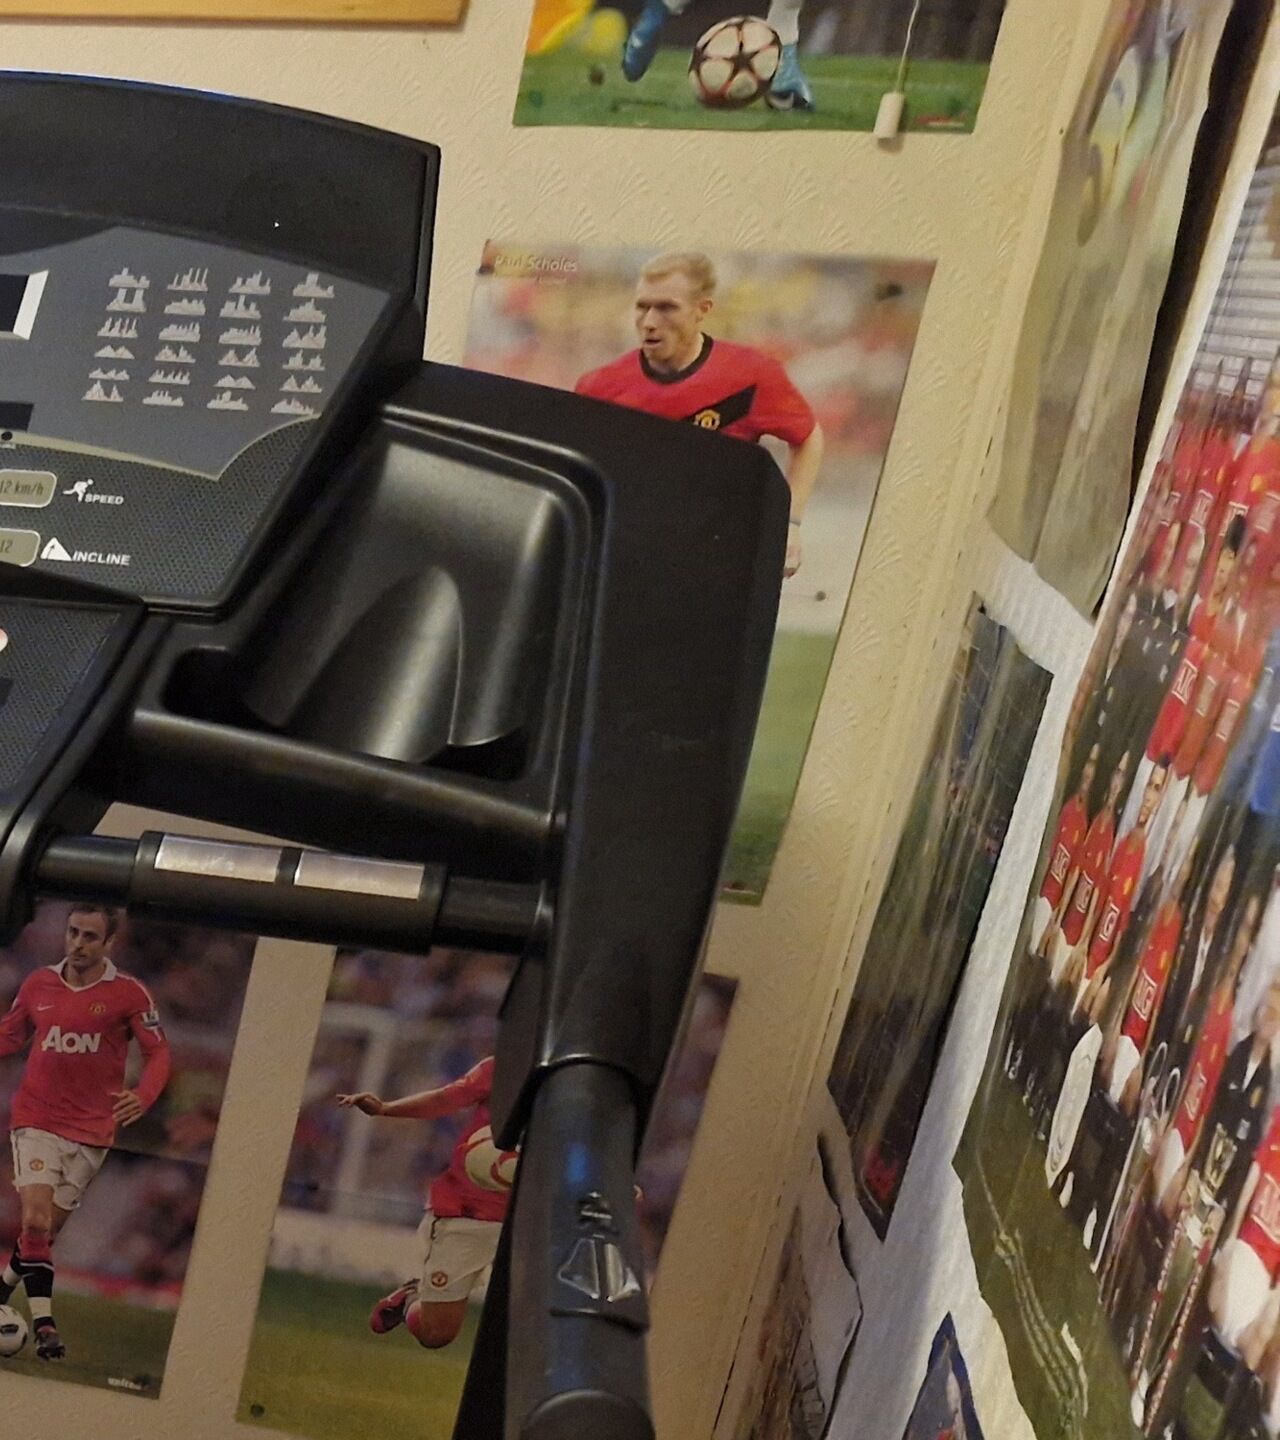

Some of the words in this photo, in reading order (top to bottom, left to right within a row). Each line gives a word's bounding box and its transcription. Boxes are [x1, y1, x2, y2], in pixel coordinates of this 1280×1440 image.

[527, 255, 577, 271] Scholes
[0, 480, 13, 493] 12
[14, 482, 44, 495] km/h
[85, 493, 125, 505] SPEED
[0, 540, 14, 553] 12
[72, 551, 131, 566] INCLINE
[41, 1026, 101, 1054] AON
